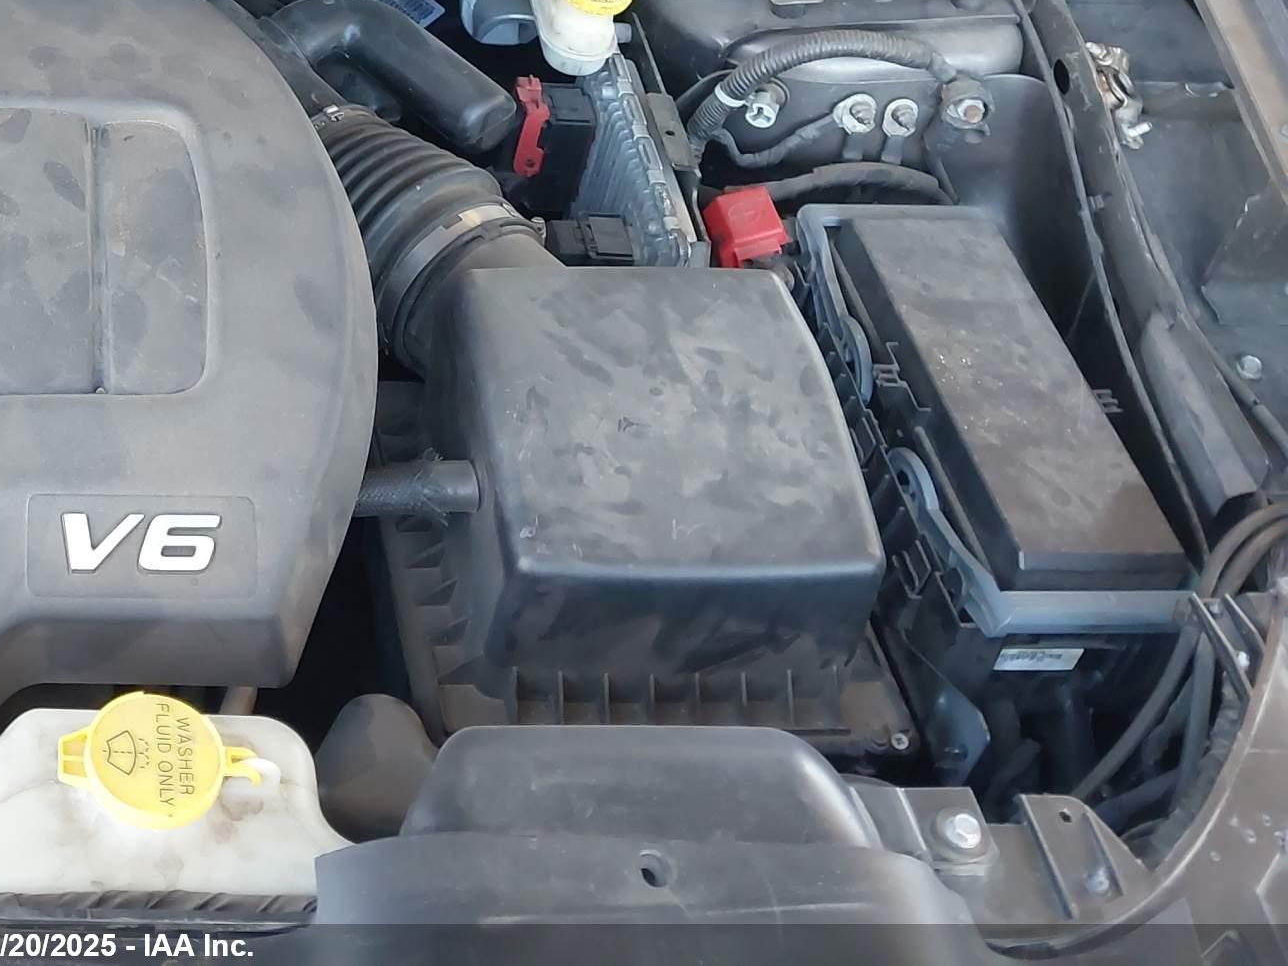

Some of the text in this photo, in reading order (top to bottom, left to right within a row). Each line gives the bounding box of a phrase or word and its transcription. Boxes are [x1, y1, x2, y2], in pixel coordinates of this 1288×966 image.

[62, 513, 221, 573] V6
[155, 703, 176, 807] FLUID ONLY
[175, 717, 195, 795] WASHER
